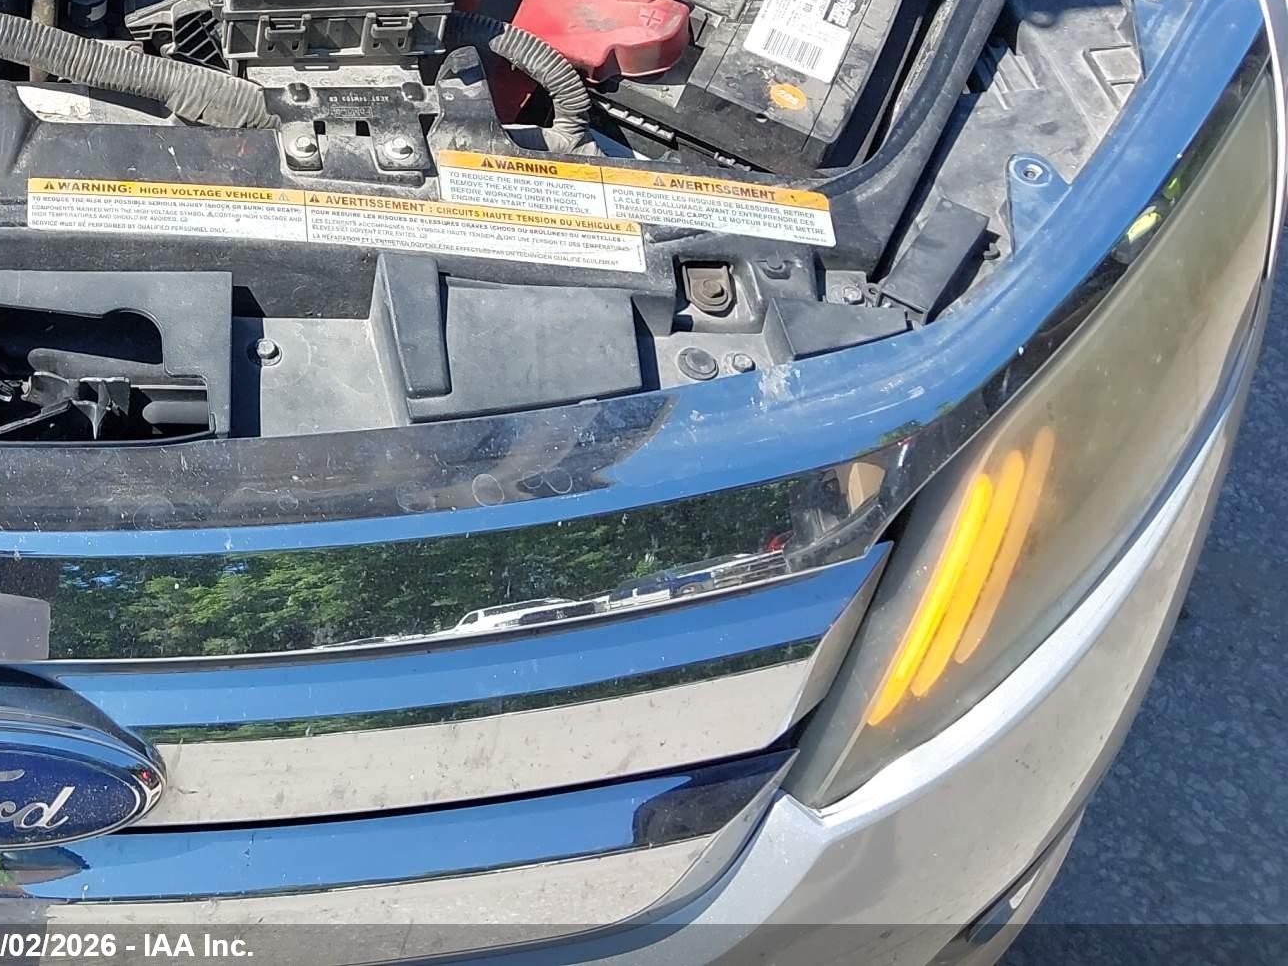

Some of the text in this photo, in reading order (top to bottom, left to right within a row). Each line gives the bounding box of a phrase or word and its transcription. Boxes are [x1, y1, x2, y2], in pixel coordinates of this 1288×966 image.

[496, 159, 557, 175] WARNING
[450, 178, 483, 188] REMOVE
[486, 182, 500, 190] THE
[503, 184, 517, 192] KEY
[520, 186, 542, 194] FROM
[545, 188, 558, 196] THE
[462, 172, 494, 182] REDUCE
[497, 175, 511, 184] THE
[514, 177, 531, 186] RISK
[534, 179, 544, 187] OF
[57, 181, 272, 200] WARNING: HIGH VOLTAGE VEHICLE
[450, 185, 482, 196] BEFORE
[484, 189, 521, 200] WORKING
[524, 193, 551, 203] UNDER
[612, 188, 634, 196] POUR
[688, 197, 721, 207] RISQUES
[669, 178, 776, 200] AVERTISSEMENT
[451, 193, 480, 203] ENGINE
[483, 197, 498, 205] MAY
[501, 199, 525, 208] START
[643, 198, 652, 206] DE
[705, 206, 729, 215] AVANT
[326, 195, 425, 212] AVERTISSEMENT
[436, 207, 480, 217] CIRCUITS
[482, 211, 512, 220] HAUTE
[517, 214, 556, 224] TENSION
[559, 218, 572, 226] DU
[614, 203, 650, 213] TRAVAUX
[652, 207, 672, 216] SOUS
[729, 217, 760, 226] MOTEUR
[763, 221, 781, 229] PEUT
[628, 211, 662, 222] MARCHE
